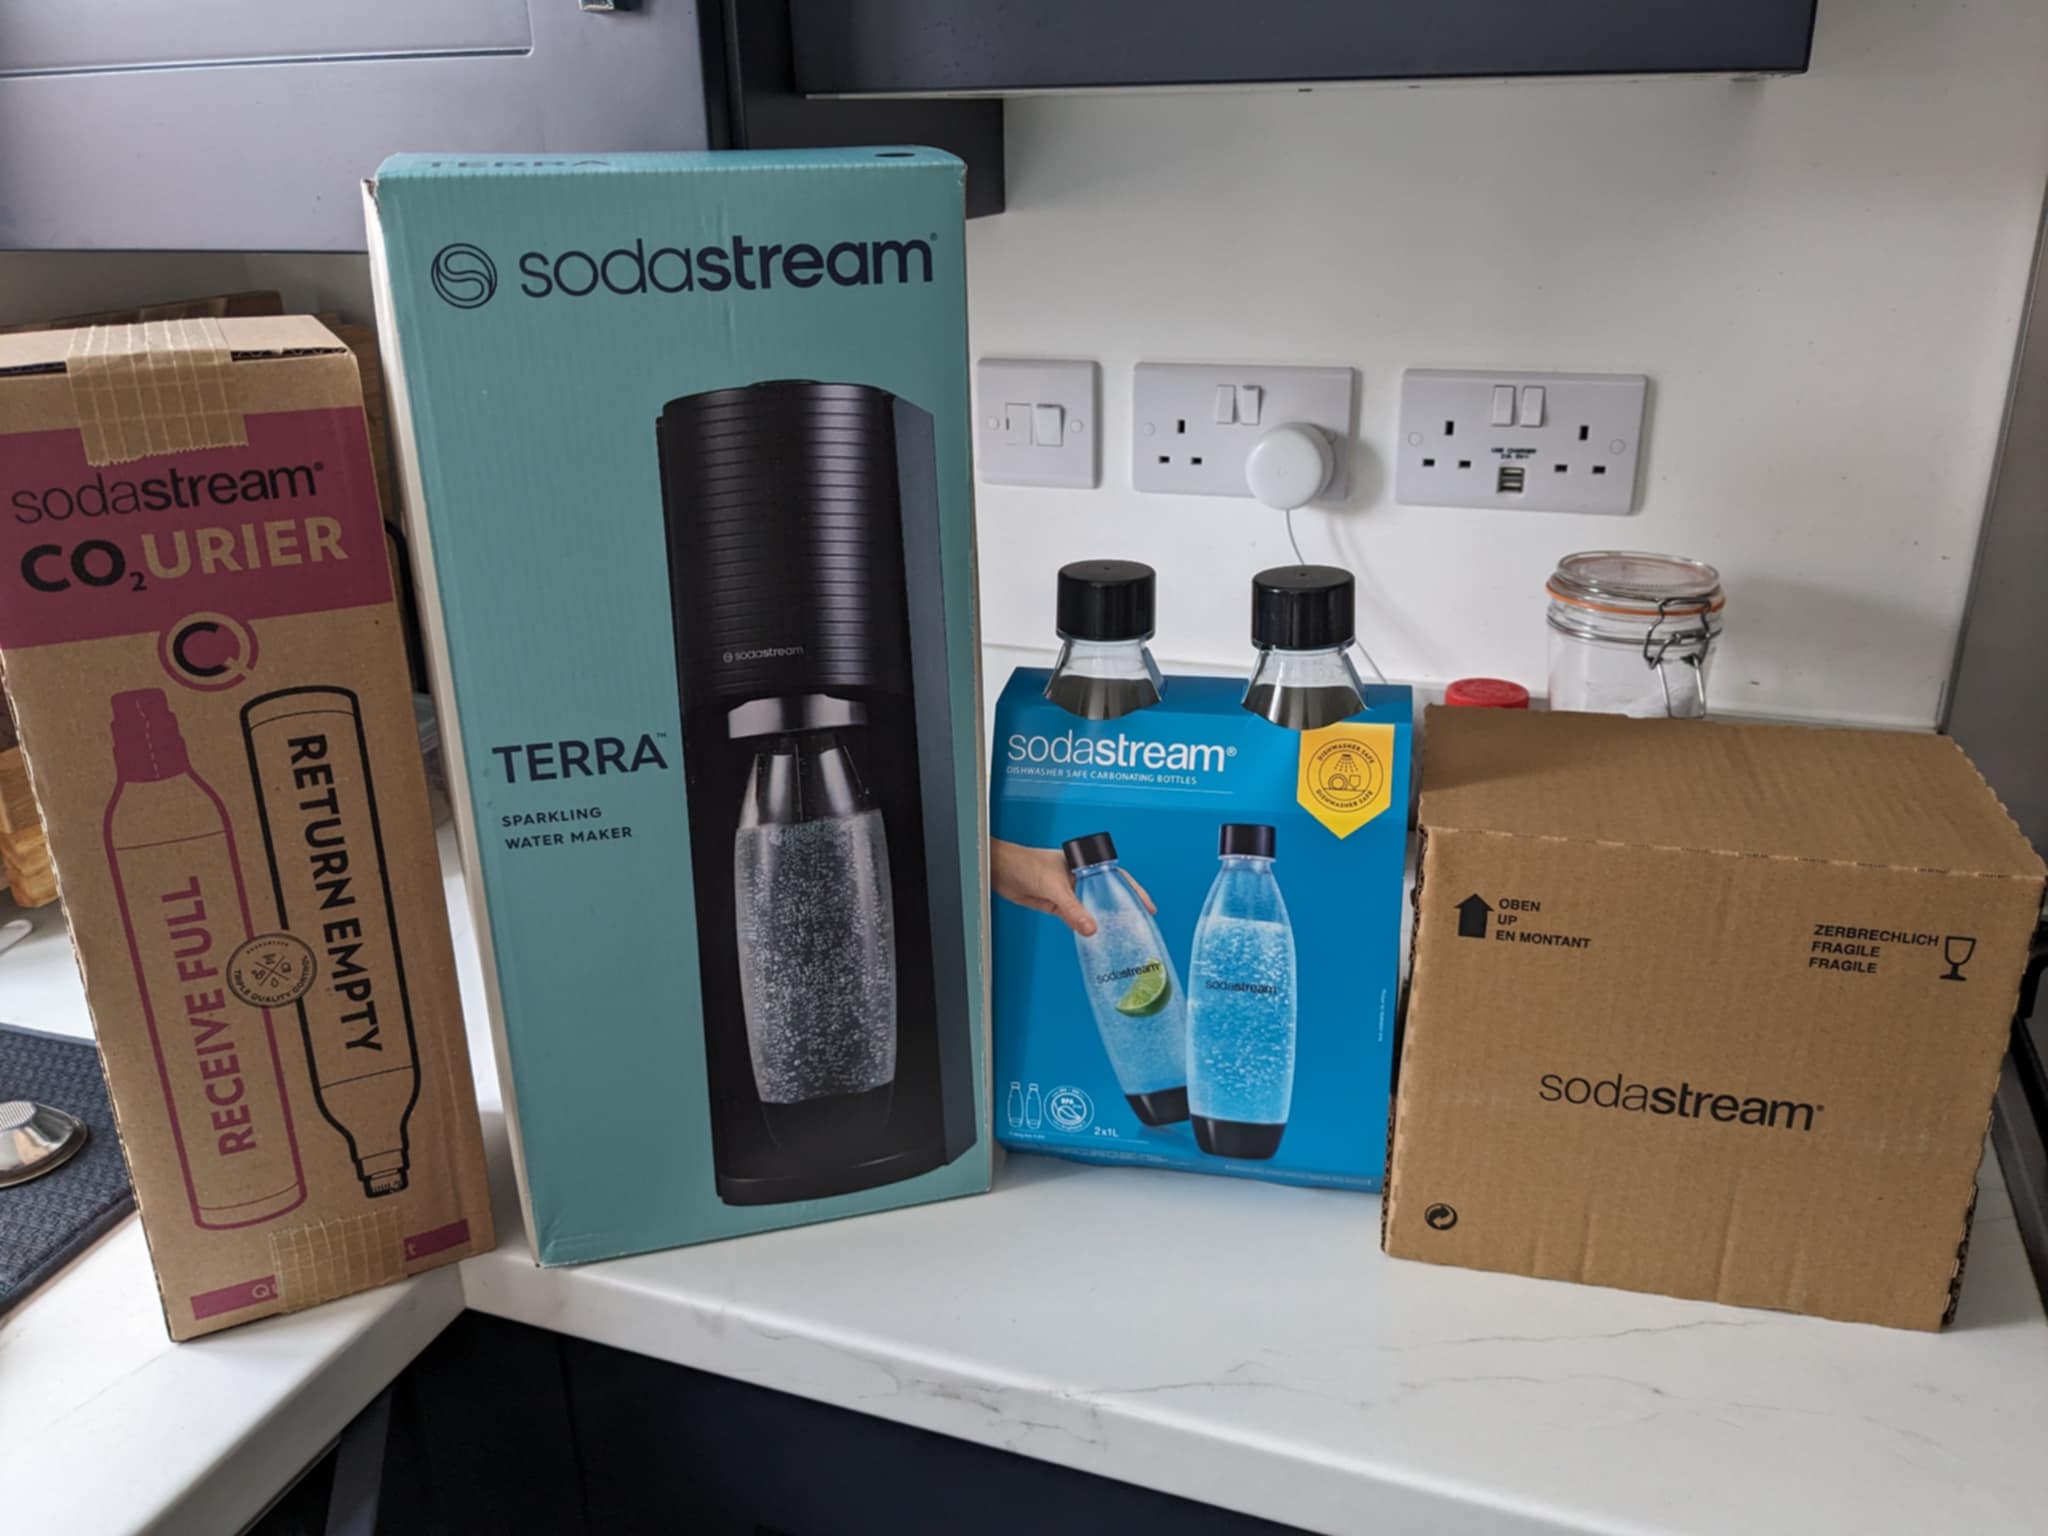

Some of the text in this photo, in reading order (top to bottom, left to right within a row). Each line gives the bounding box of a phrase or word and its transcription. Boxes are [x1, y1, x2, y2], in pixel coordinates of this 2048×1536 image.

[1006, 765, 1198, 785] DISHWASHER SAFE CARBONATING BOTTLES
[502, 806, 602, 828] SPARKLING
[505, 826, 632, 850] WATER MAKER
[287, 734, 382, 1052] RETURN EMPTY
[1498, 898, 1541, 912] OBEN
[1497, 914, 1518, 926] UP
[1495, 930, 1591, 949] EN MONTANT
[1814, 924, 1939, 947] ZERBRECHLICH
[1811, 941, 1881, 958] FRAGILE
[1808, 957, 1878, 974] FRAGILE
[1205, 978, 1278, 995] sodastream
[161, 876, 257, 1156] RECEIVE FULL
